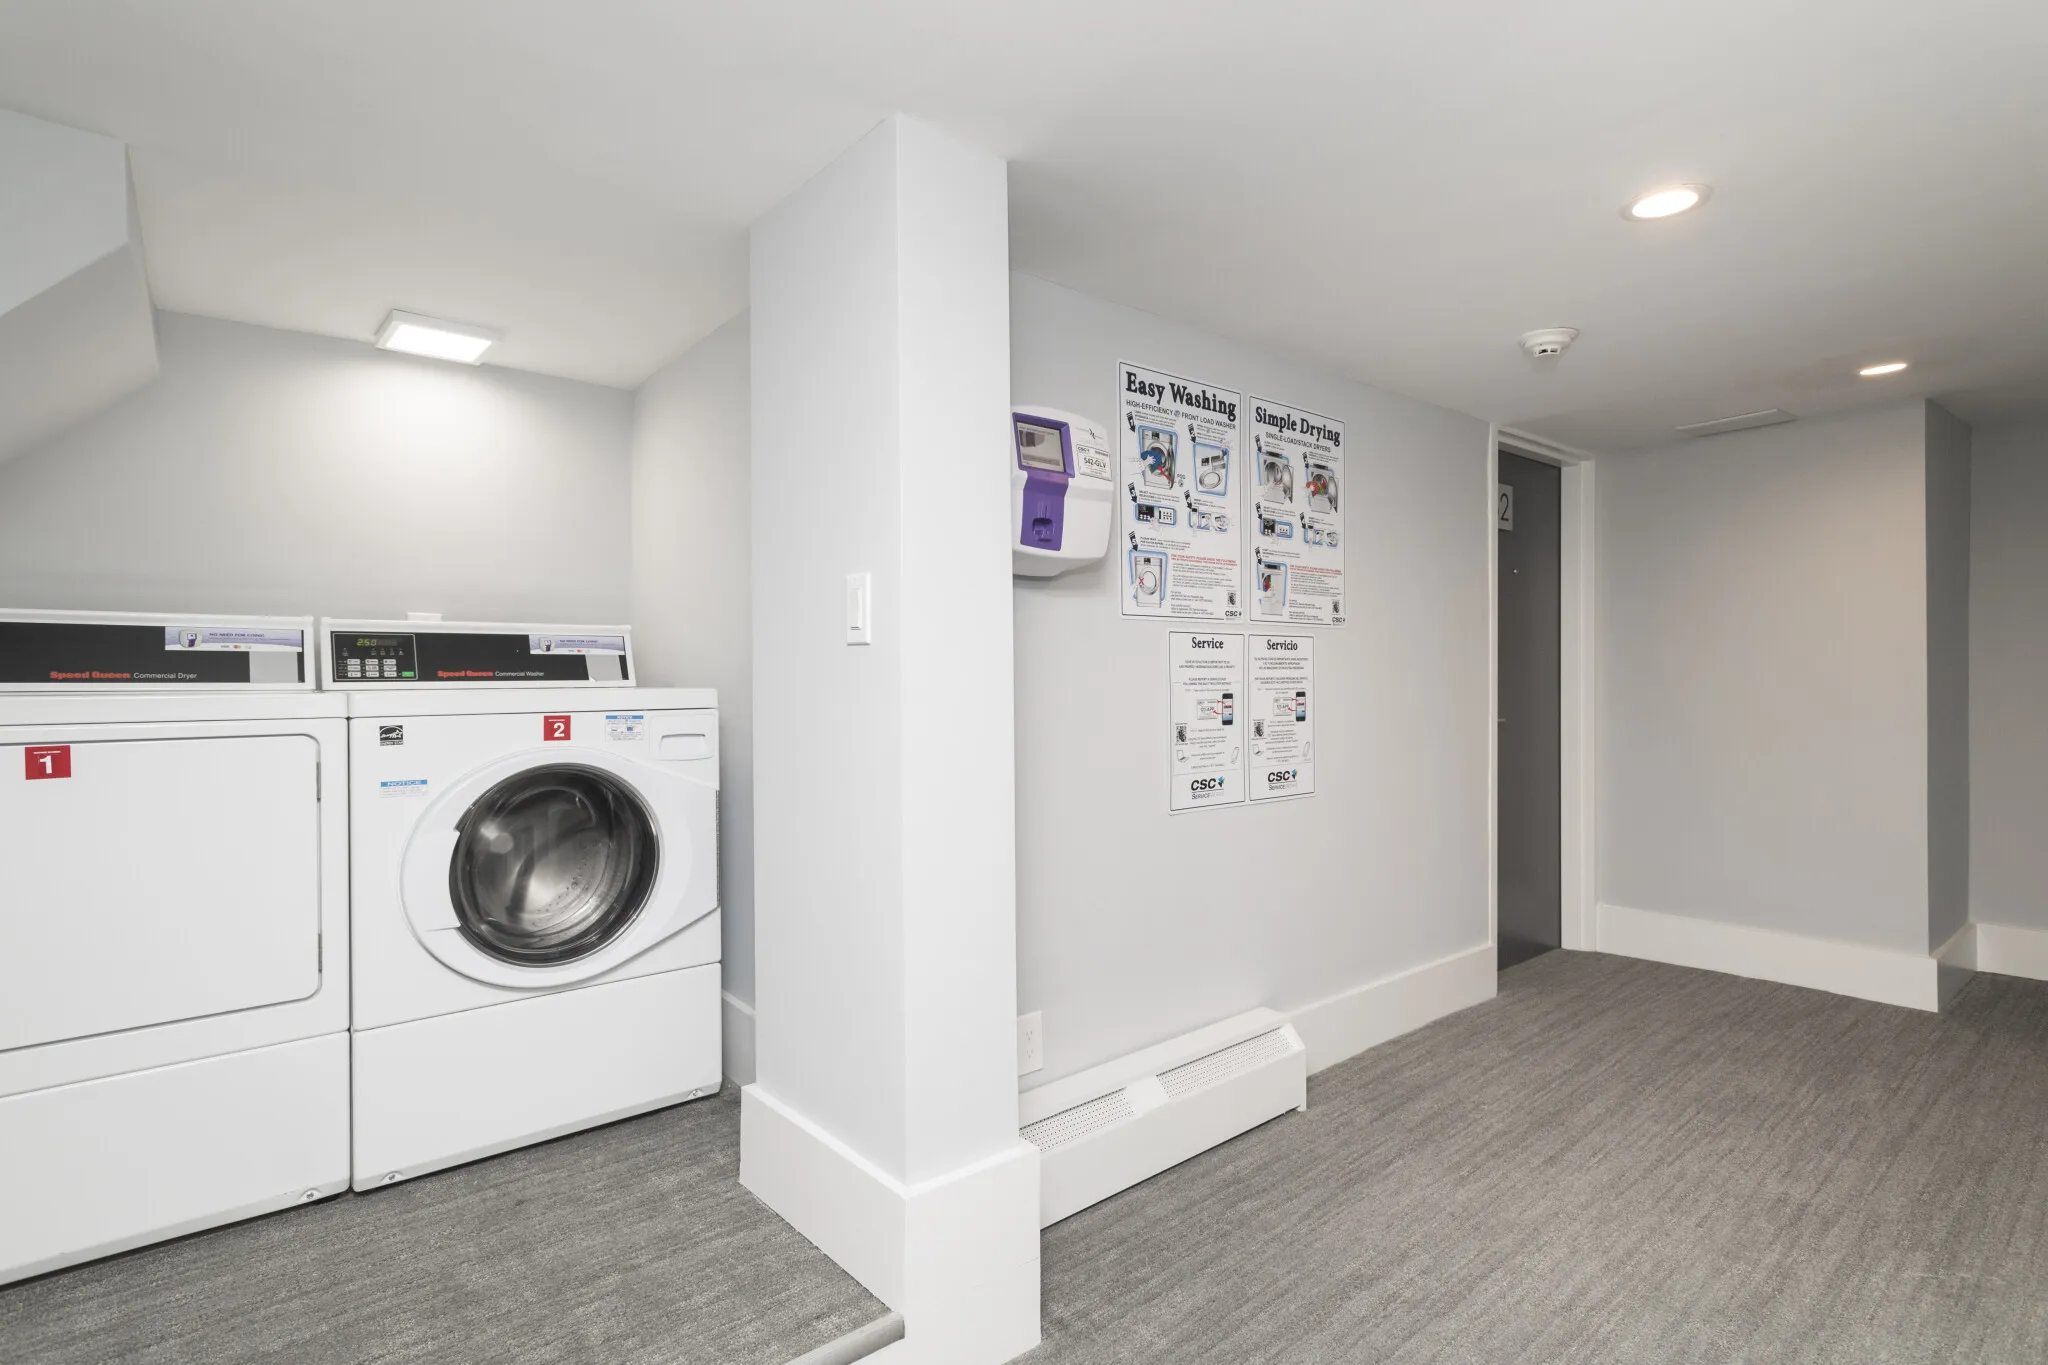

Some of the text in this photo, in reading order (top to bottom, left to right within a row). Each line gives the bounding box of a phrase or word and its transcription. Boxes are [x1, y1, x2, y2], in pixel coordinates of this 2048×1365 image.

[1125, 371, 1166, 405] Easy
[1169, 382, 1237, 422] Washing
[1126, 399, 1174, 416] HIGH-EFFICIENCY
[1182, 412, 1199, 423] FRONT
[1200, 417, 1215, 426] LOAD
[1215, 420, 1236, 431] WASHER
[1255, 406, 1298, 434] Simple
[1300, 418, 1341, 447] Drying
[1313, 443, 1332, 454] DRYERS
[1332, 616, 1343, 624] CSC
[1191, 636, 1224, 650] Service
[1266, 638, 1298, 651] Servicio
[50, 671, 198, 680] Speed Queen Commercial Dryer
[437, 670, 466, 678] Speed
[466, 670, 494, 678] Queen
[553, 722, 566, 738] 2
[39, 755, 53, 774] 1
[1267, 770, 1291, 783] CSC
[1190, 778, 1217, 791] CSC
